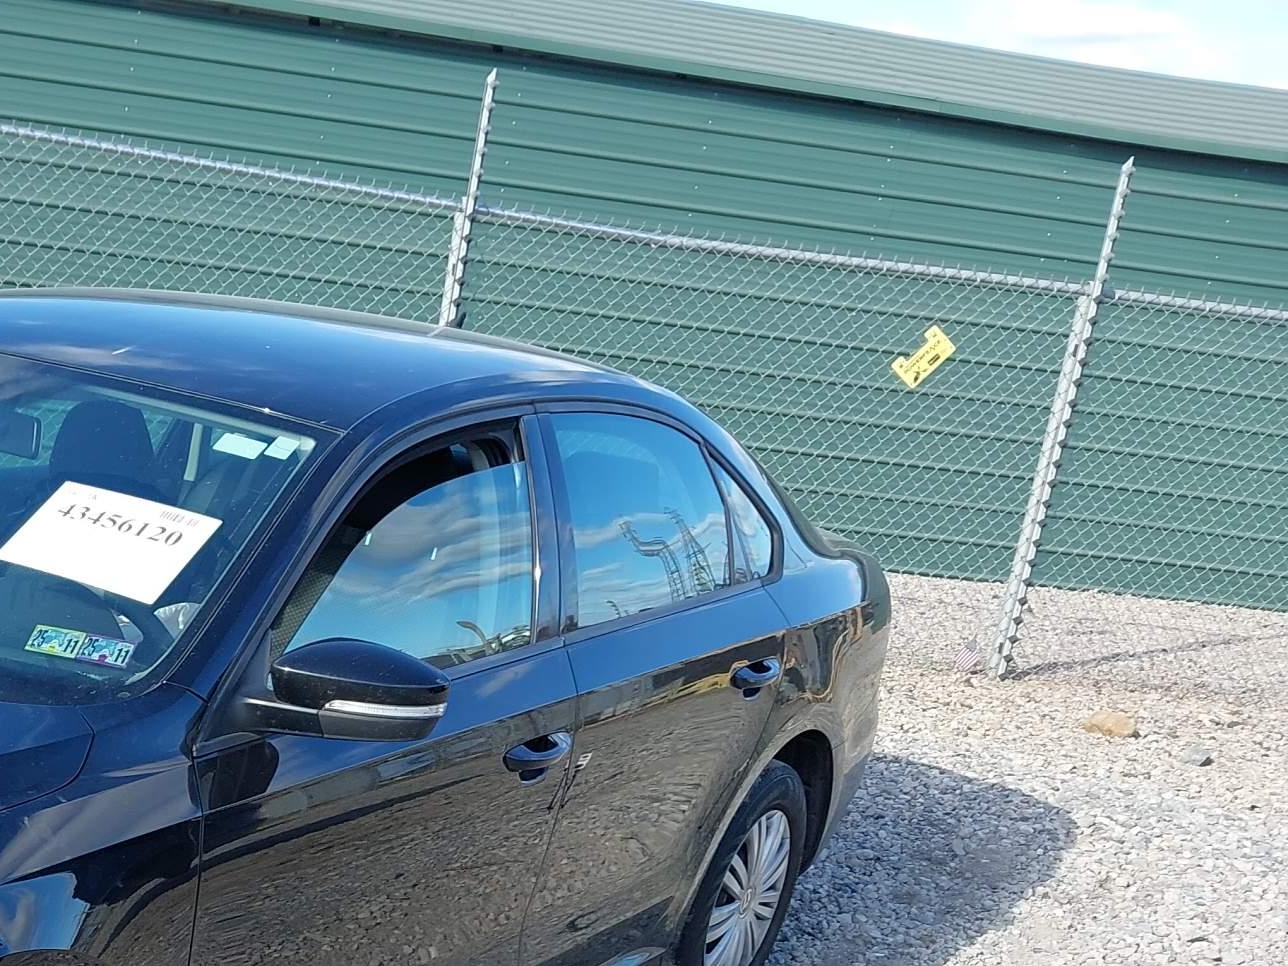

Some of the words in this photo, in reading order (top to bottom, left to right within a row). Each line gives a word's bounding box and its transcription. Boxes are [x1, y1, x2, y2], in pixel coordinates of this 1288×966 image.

[57, 503, 183, 546] 43456120
[31, 628, 49, 648] 25
[81, 637, 99, 657] 25
